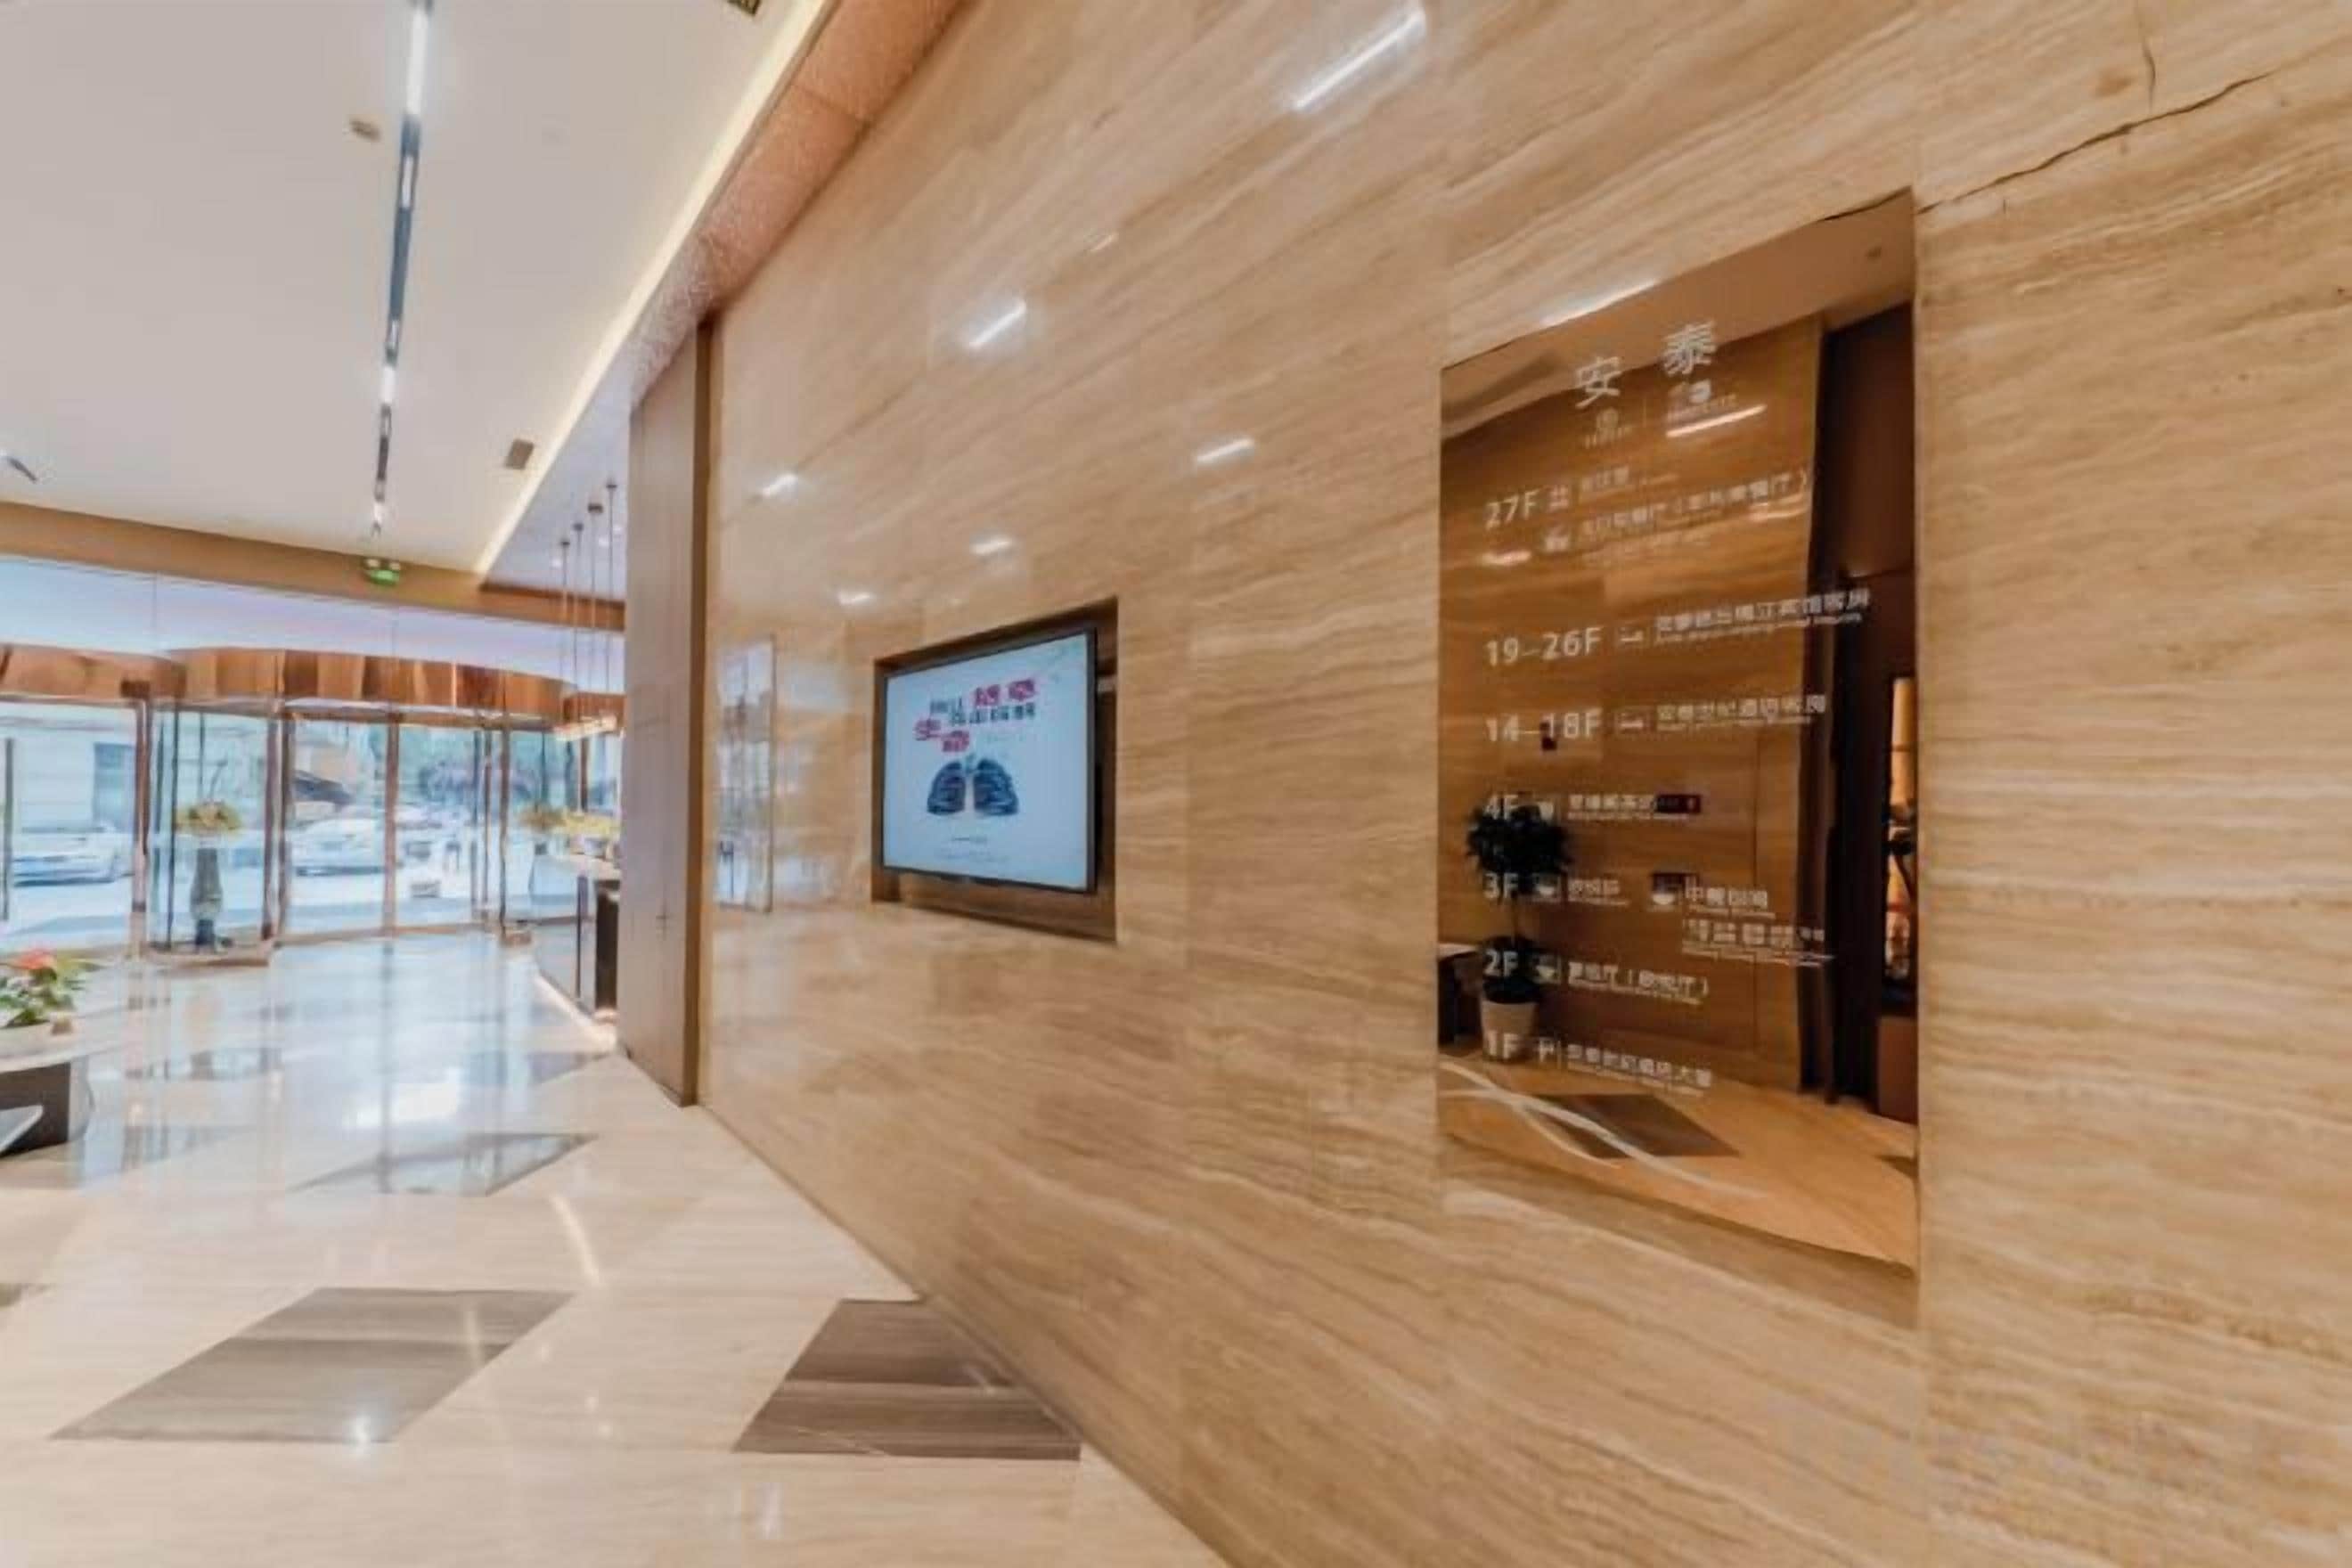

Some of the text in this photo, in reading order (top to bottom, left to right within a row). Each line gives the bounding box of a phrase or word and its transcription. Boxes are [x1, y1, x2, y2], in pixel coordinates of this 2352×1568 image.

[1484, 487, 1543, 530] 27F
[1483, 872, 1520, 901] 3F
[1484, 950, 1519, 978] 2F
